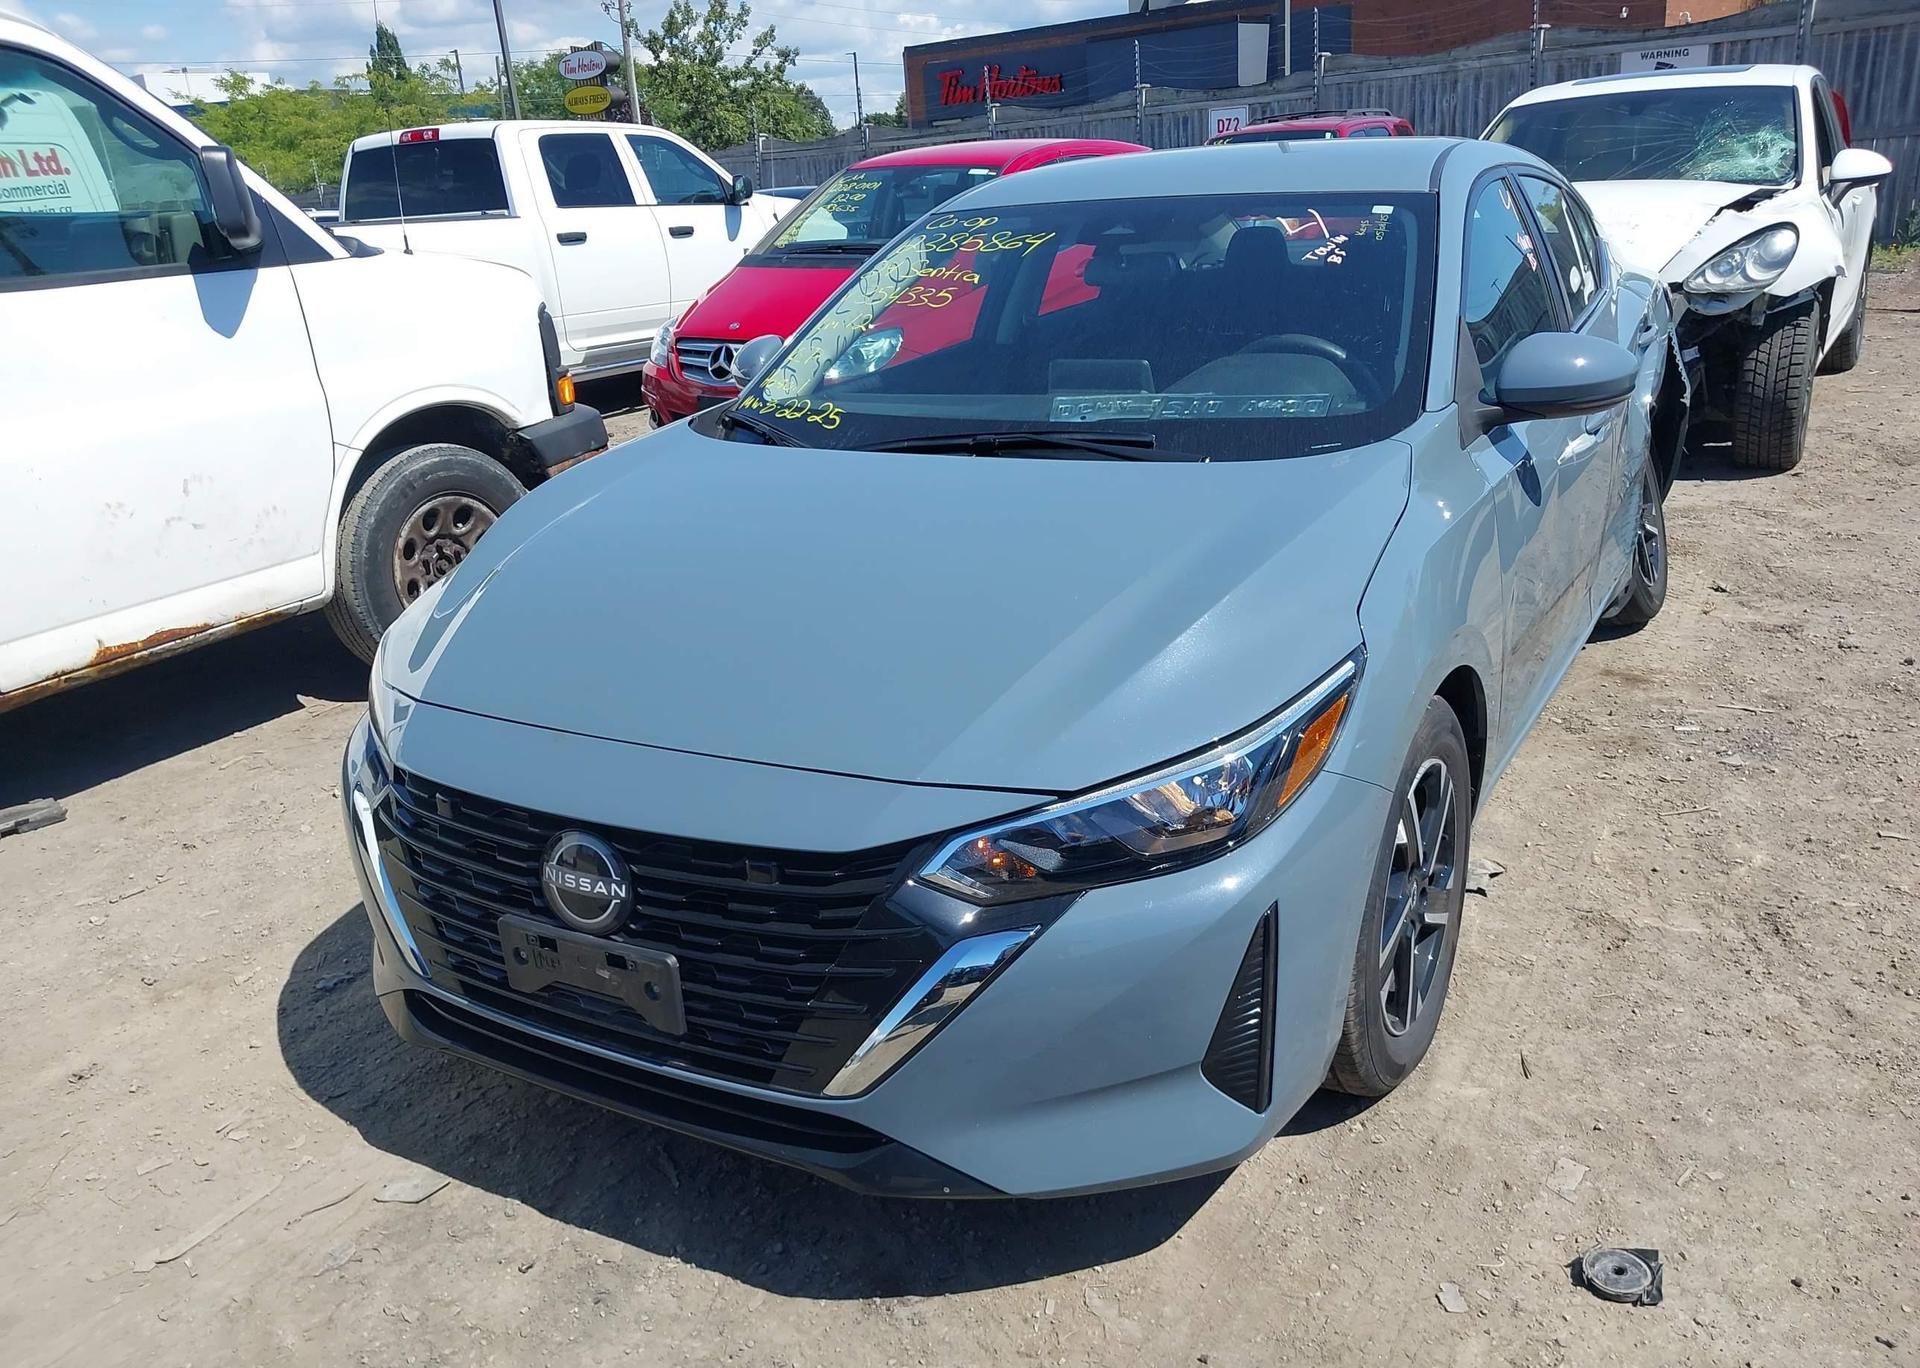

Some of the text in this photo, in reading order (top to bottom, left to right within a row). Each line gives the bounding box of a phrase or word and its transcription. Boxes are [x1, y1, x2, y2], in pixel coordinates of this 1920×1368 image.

[1640, 48, 1690, 60] WARNING
[562, 59, 577, 75] Tim
[937, 64, 1063, 107] Tim Hortons
[588, 93, 608, 105] FRESH
[17, 147, 71, 177] Ltd.
[0, 179, 71, 199] ommercial
[925, 214, 999, 232] Co-op
[900, 259, 981, 285] Sentra
[544, 866, 626, 898] NISSAN
